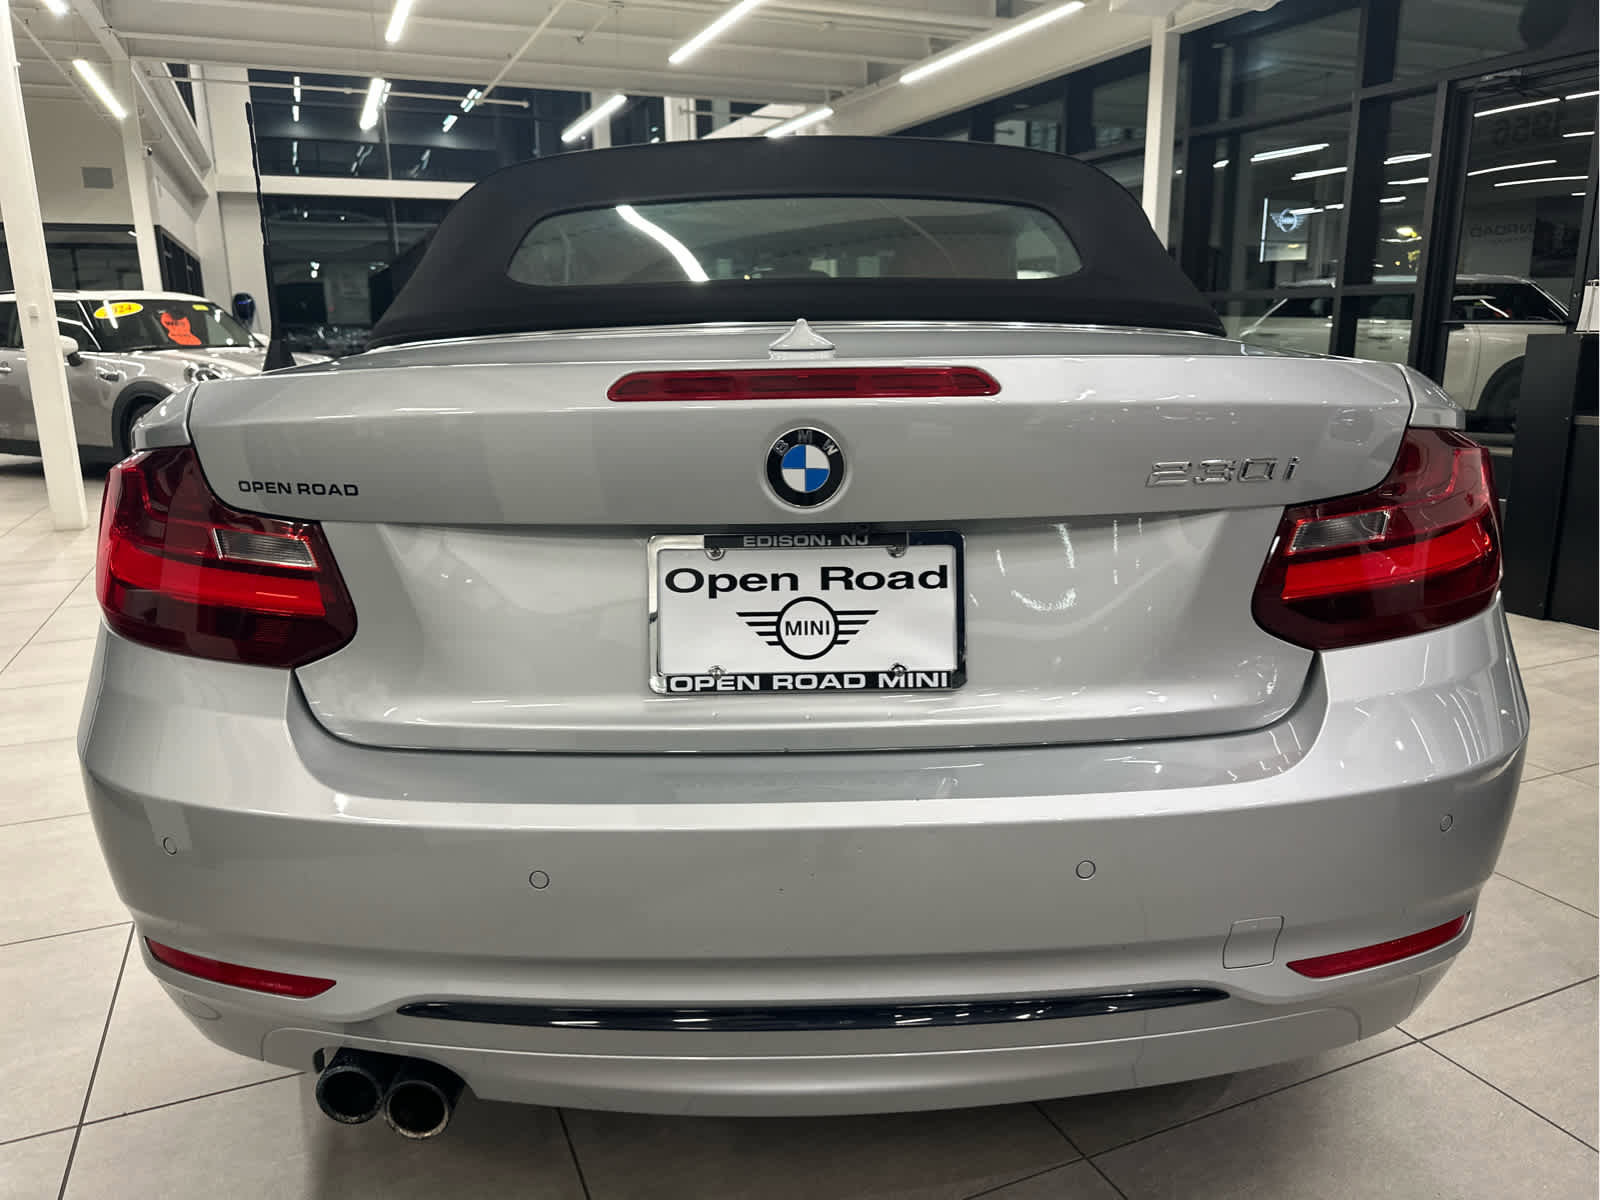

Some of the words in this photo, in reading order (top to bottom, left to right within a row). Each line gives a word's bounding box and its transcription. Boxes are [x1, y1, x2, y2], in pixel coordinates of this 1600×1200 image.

[772, 430, 839, 457] BMW
[238, 480, 292, 495] OPEN
[297, 483, 359, 496] ROAD
[743, 534, 833, 548] EDISON,
[840, 534, 869, 546] NJ
[665, 568, 799, 599] Open
[820, 565, 948, 591] Road
[785, 620, 830, 636] MINI
[669, 675, 760, 692] OPEN
[772, 674, 867, 690] ROAD
[878, 672, 948, 688] MINI
